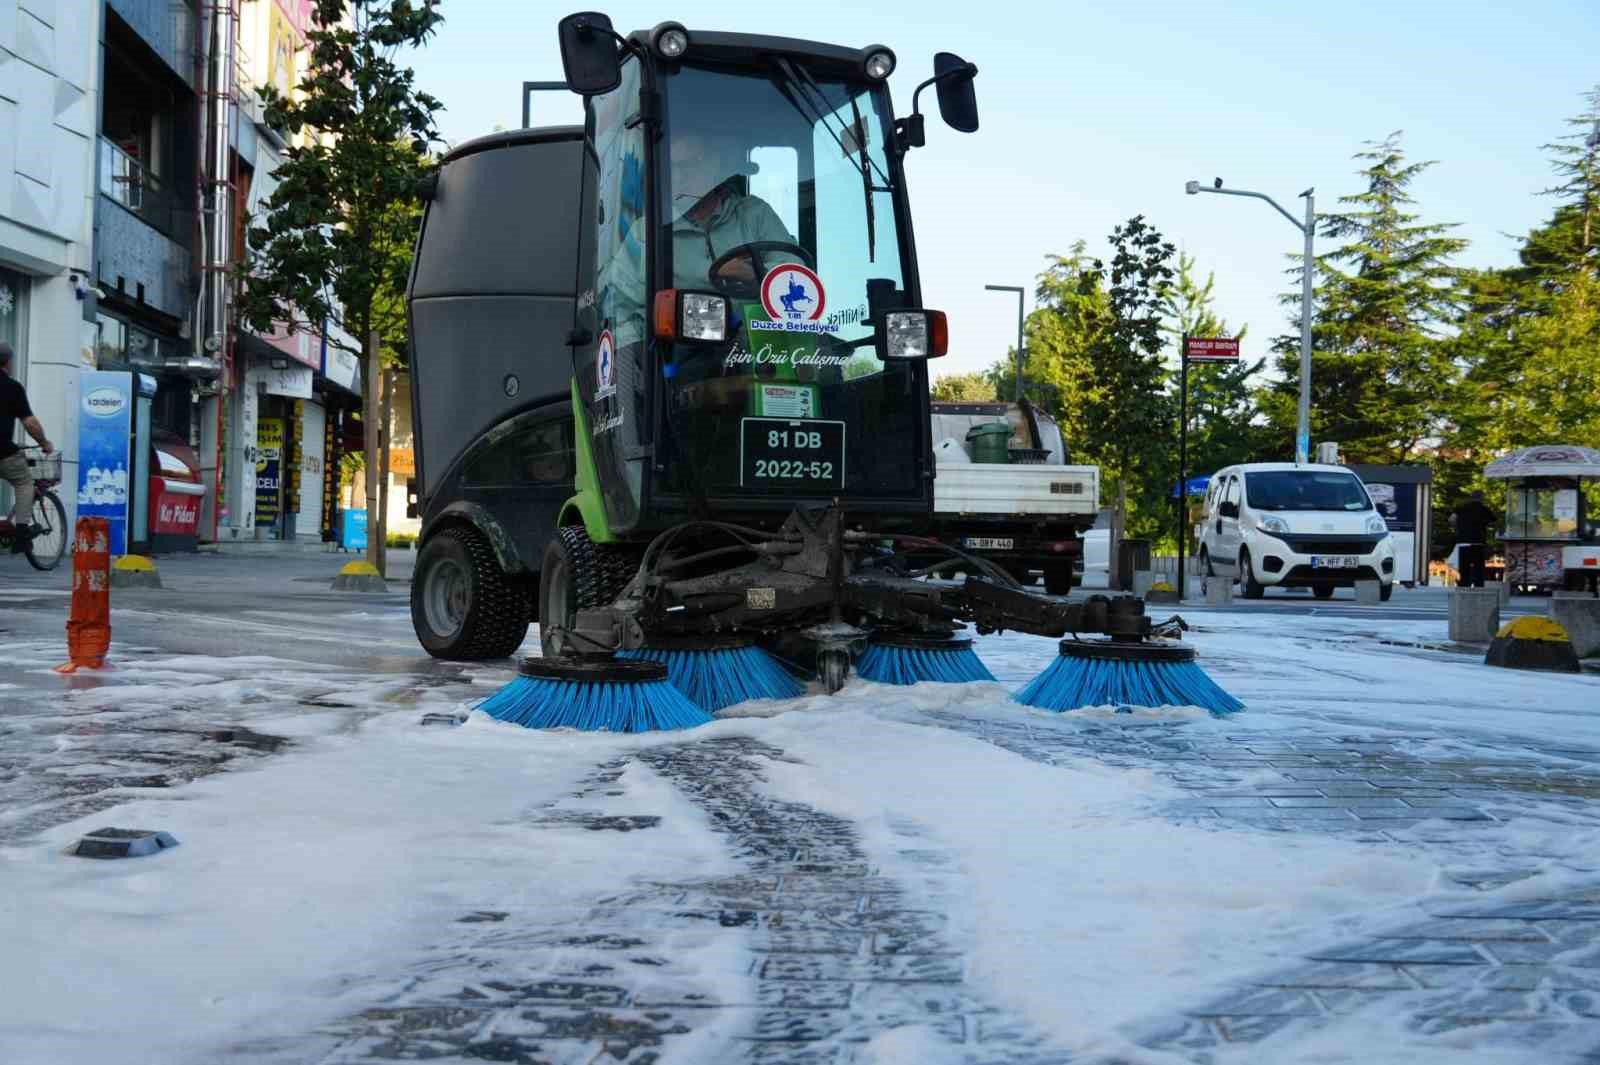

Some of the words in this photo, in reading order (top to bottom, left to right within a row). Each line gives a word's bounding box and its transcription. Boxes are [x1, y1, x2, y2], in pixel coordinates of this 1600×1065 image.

[786, 321, 839, 335] Belediyesi
[756, 343, 789, 364] Özü
[87, 396, 122, 408] kardelen
[767, 430, 788, 448] 81
[794, 431, 822, 448] DB
[755, 460, 833, 479] 2022-52
